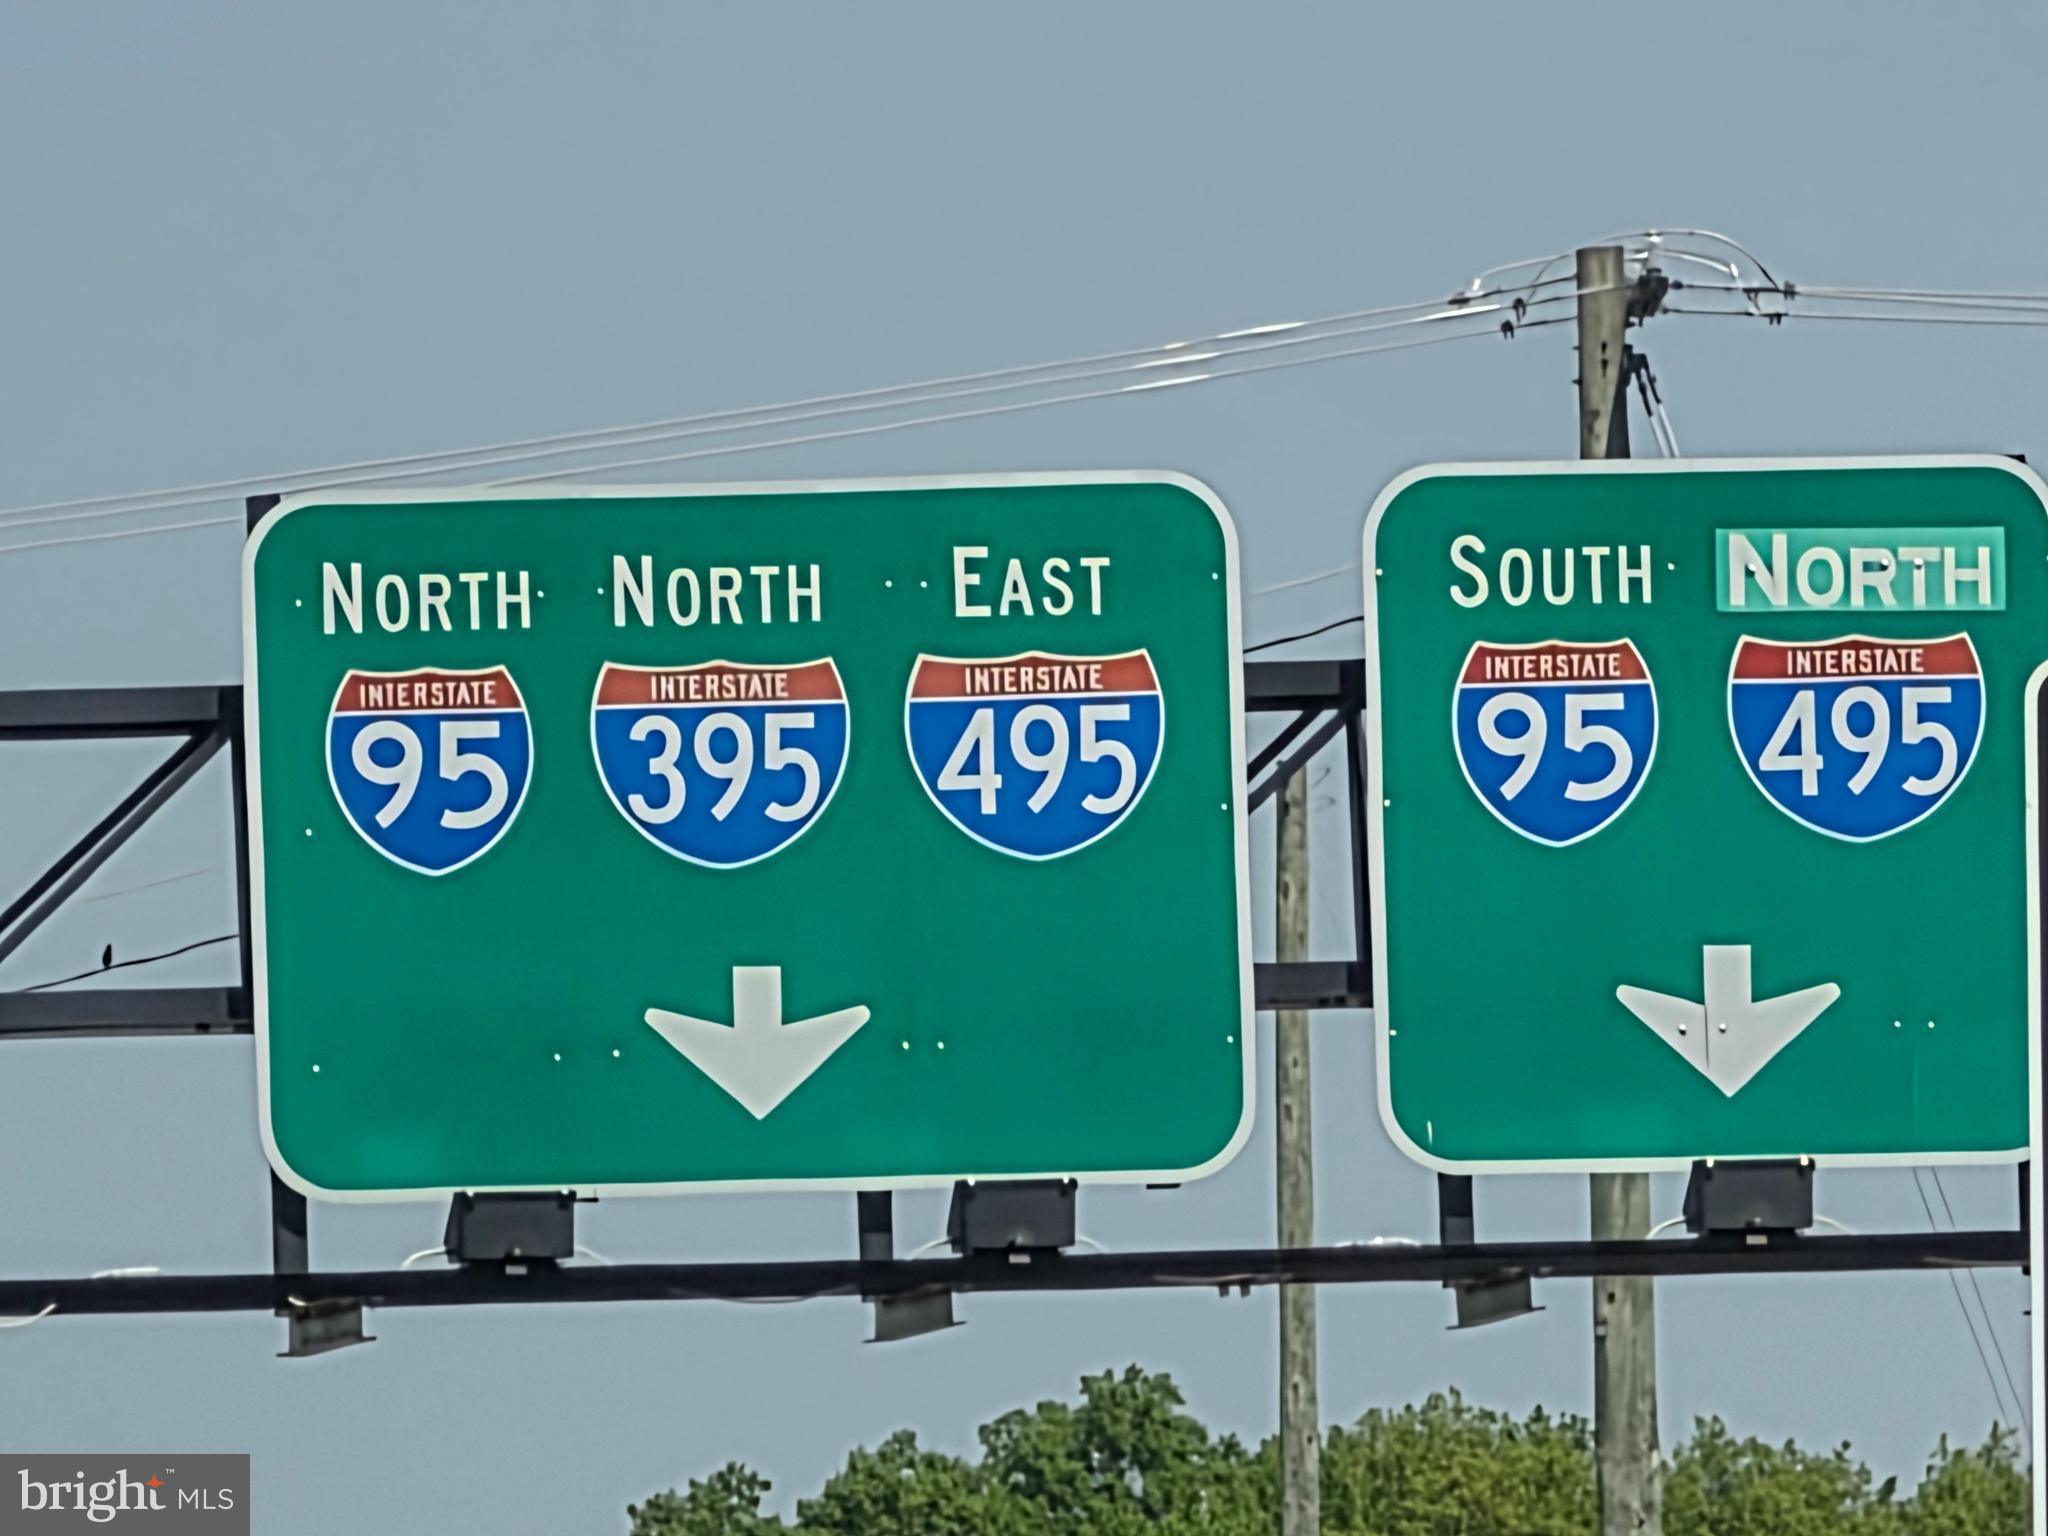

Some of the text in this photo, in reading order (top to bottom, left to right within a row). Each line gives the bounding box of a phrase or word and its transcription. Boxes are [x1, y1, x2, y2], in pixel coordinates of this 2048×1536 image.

[322, 562, 531, 634] NORTH
[612, 554, 821, 627] NORTH
[953, 546, 1110, 617] EAST
[1450, 535, 1652, 608] SOUTH
[1727, 533, 1992, 606] NORTH
[359, 680, 497, 708] INTERSTATE
[650, 672, 789, 700] INTERSTATE
[964, 663, 1103, 694] INTERSTATE
[1484, 652, 1621, 680] INTERSTATE
[1786, 647, 1924, 674] INTERSTATE
[351, 719, 509, 830] 95
[627, 711, 821, 825] 395
[936, 703, 1137, 815] 495
[1476, 691, 1634, 802] 95
[1758, 685, 1959, 797] 495
